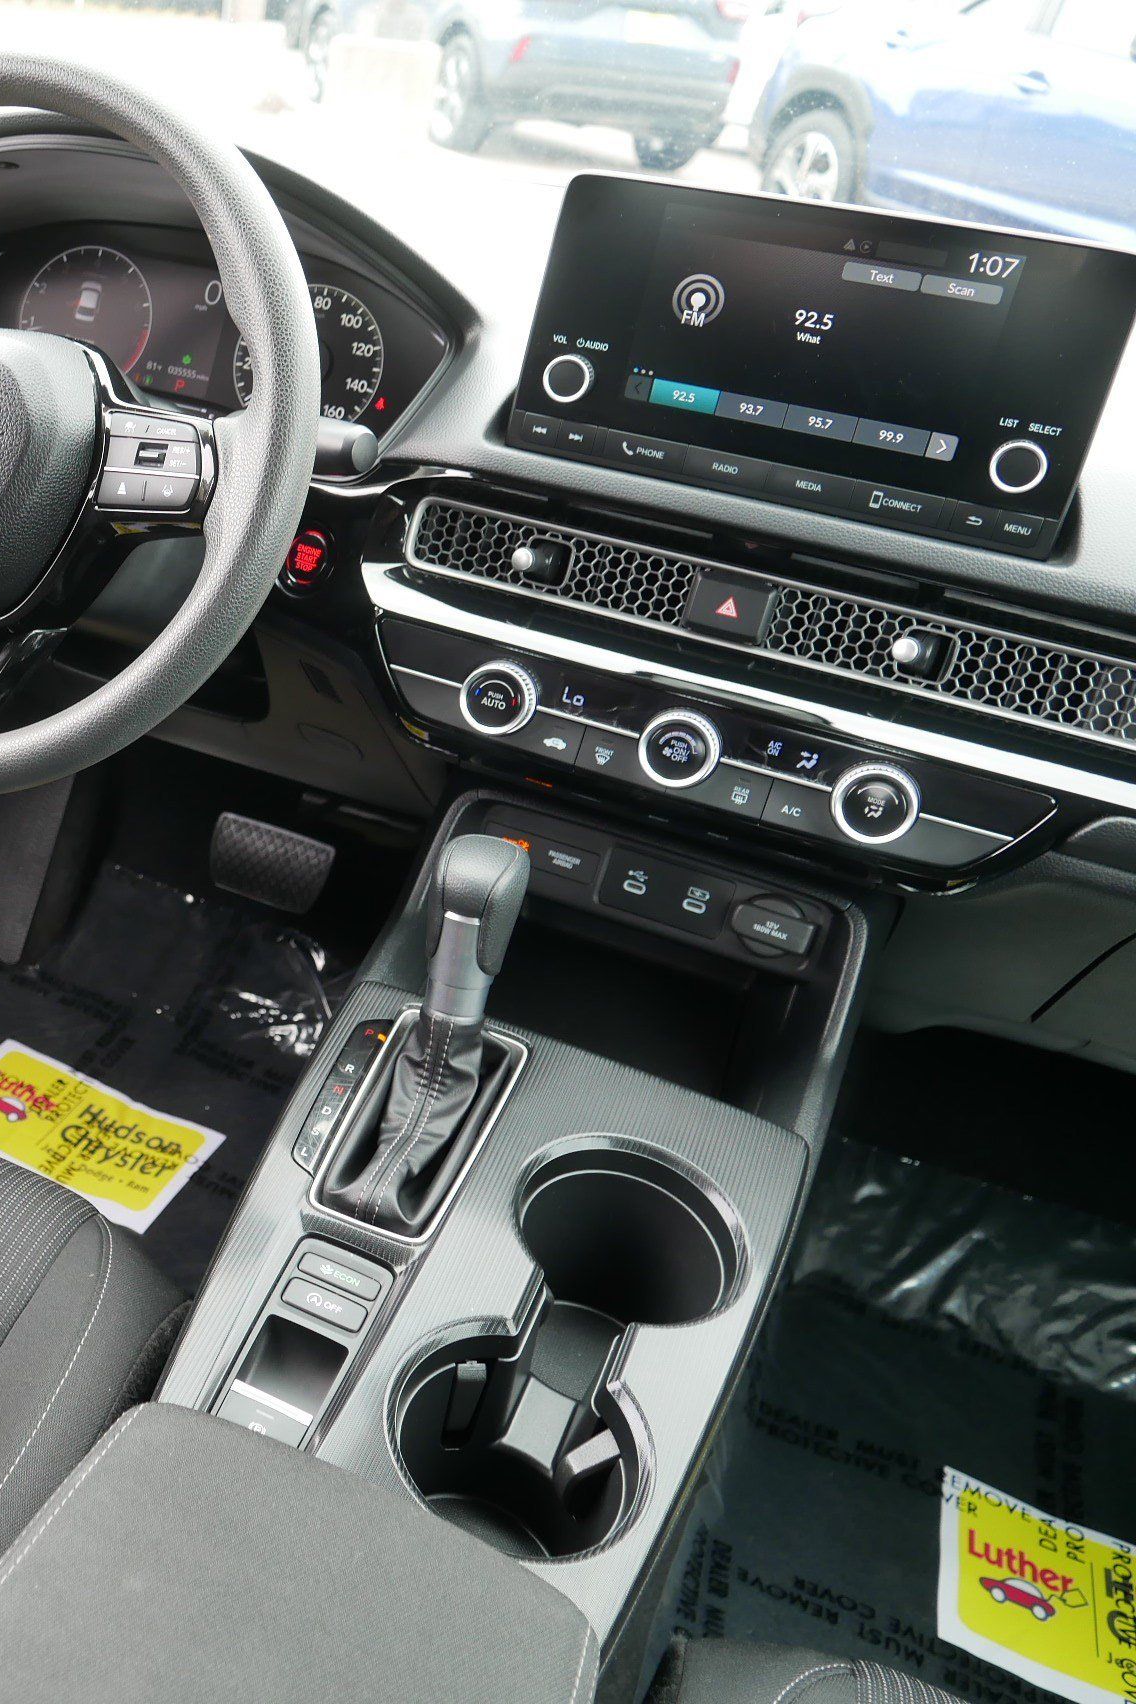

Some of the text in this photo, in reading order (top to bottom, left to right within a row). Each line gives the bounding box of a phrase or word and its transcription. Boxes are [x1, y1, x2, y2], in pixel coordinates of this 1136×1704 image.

[968, 252, 1020, 278] 1:07
[870, 269, 895, 284] Text
[947, 283, 975, 298] Scan
[313, 296, 331, 310] 80
[340, 313, 362, 329] 100
[681, 309, 706, 328] FM
[794, 309, 835, 331] 92.5
[553, 334, 568, 345] VOL
[796, 331, 822, 345] What
[351, 341, 374, 357] 120
[585, 340, 609, 351] AUDIO
[174, 379, 186, 392] P
[345, 378, 368, 393] 140
[673, 390, 695, 403] 92.5
[323, 405, 345, 420] 160
[739, 402, 763, 416] 93.7
[808, 416, 833, 430] 95.7
[999, 417, 1019, 428] LIST
[1028, 422, 1062, 436] SELECT
[879, 430, 904, 444] 99.9
[636, 446, 665, 460] PHONE
[712, 462, 739, 475] RADIO
[795, 479, 822, 492] MEDIA
[882, 498, 922, 513] CONNECT
[1004, 523, 1032, 536] MENU
[296, 551, 318, 564] START
[297, 543, 322, 558] ENGINE
[295, 561, 314, 572] STOP
[487, 691, 504, 701] PUSH
[481, 697, 506, 711] AUTO
[595, 746, 613, 756] FRONT
[670, 739, 688, 749] PUSH
[768, 740, 783, 750] A/C
[670, 753, 688, 764] OFF
[767, 747, 779, 757] ON
[734, 785, 750, 795] REAR
[867, 796, 886, 806] MODE
[781, 805, 802, 817] A/C
[771, 929, 788, 940] MAX
[365, 1028, 374, 1037] P
[344, 1063, 355, 1073] R
[321, 1105, 332, 1115] D
[77, 1103, 182, 1155] Hudson
[60, 1124, 175, 1178] Chrysler
[301, 1147, 308, 1157] L
[333, 1269, 361, 1288] ECON
[323, 1300, 343, 1315] OFF
[967, 1528, 1073, 1593] Luther
[793, 1575, 876, 1620] COVER
